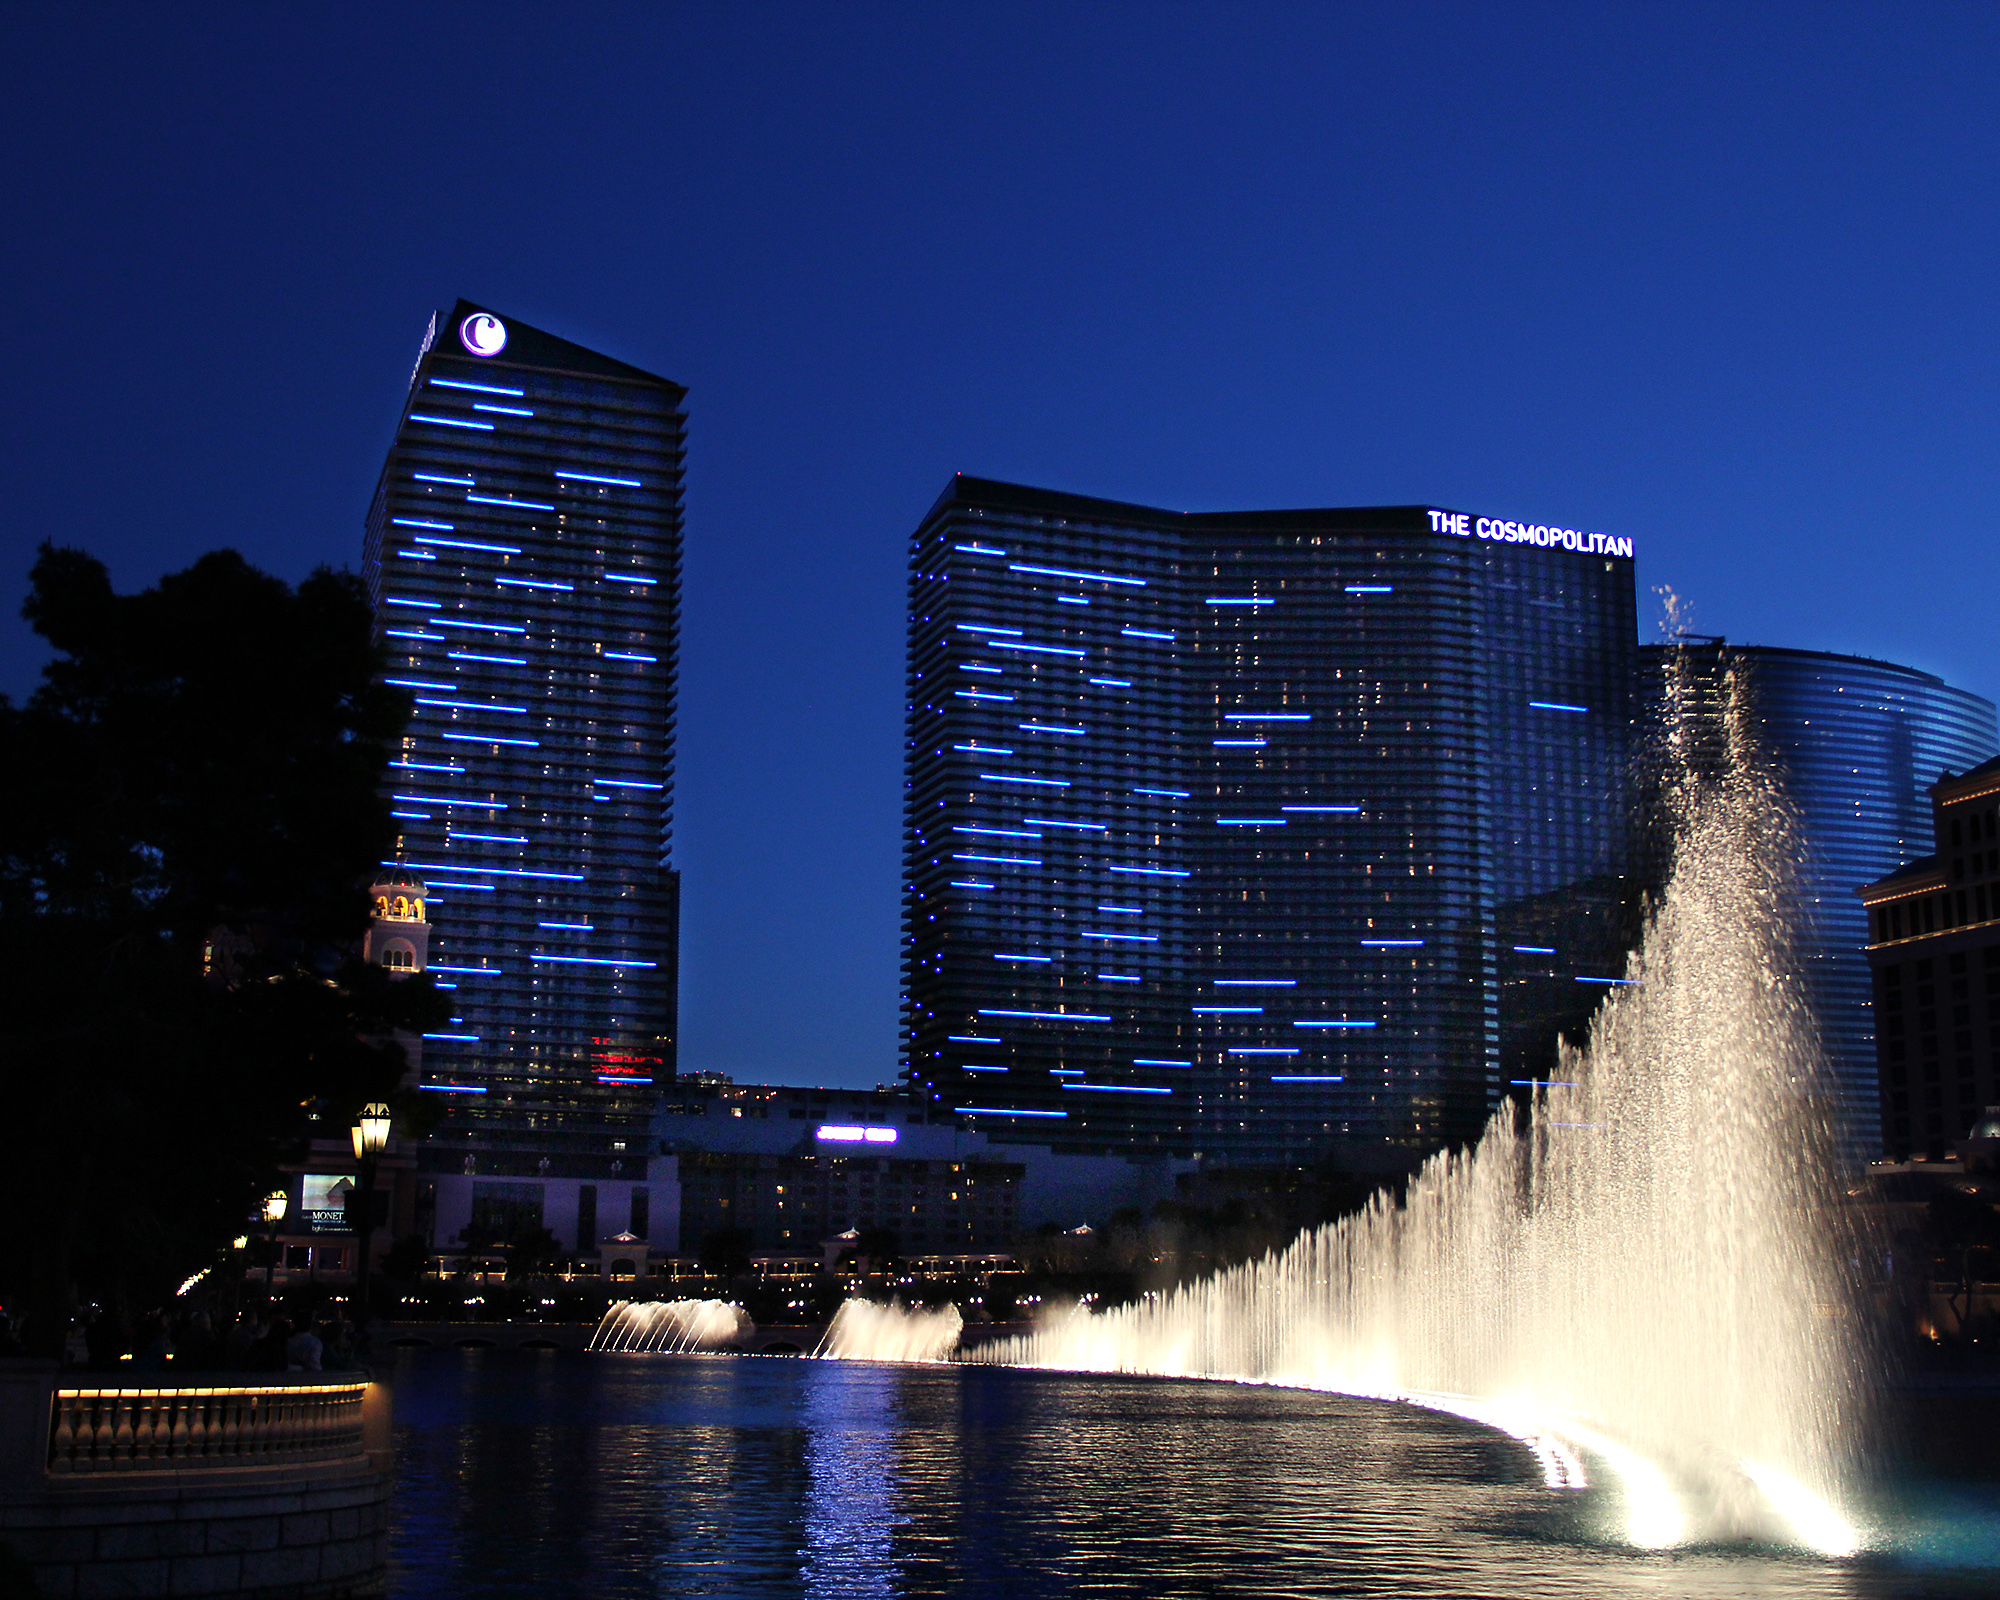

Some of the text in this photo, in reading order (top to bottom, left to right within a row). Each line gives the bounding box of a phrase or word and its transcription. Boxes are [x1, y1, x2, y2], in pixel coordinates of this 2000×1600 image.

[1427, 510, 1633, 558] THE COSMOPOLITAN
[312, 1211, 344, 1220] MONET
